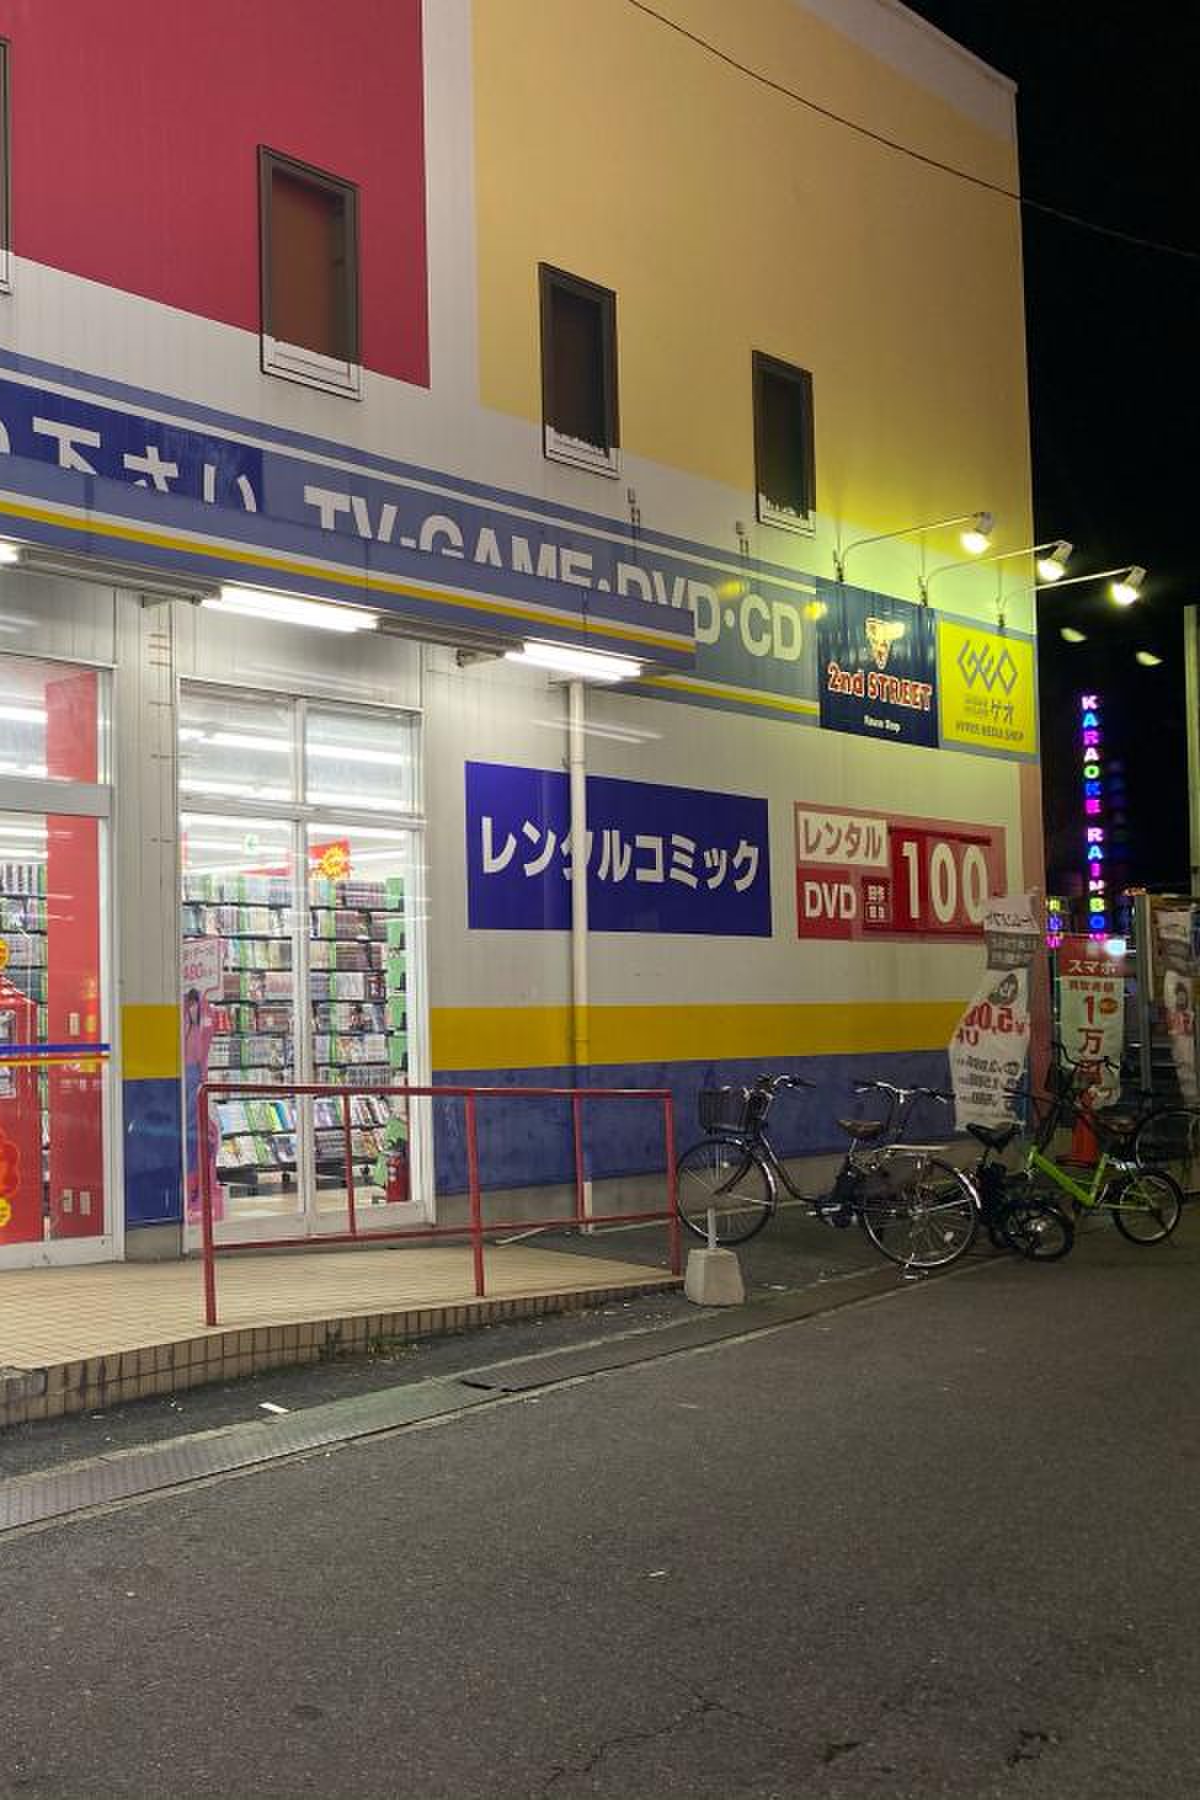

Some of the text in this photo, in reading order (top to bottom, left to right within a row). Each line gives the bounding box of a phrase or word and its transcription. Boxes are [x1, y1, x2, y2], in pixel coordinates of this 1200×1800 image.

[827, 661, 864, 698] 2nd
[867, 671, 933, 711] STREET
[1082, 696, 1101, 814] KARAOKE
[804, 815, 881, 859] レンタル
[804, 881, 857, 919] DVD
[902, 841, 988, 924] 100
[1069, 959, 1117, 975] スマホ
